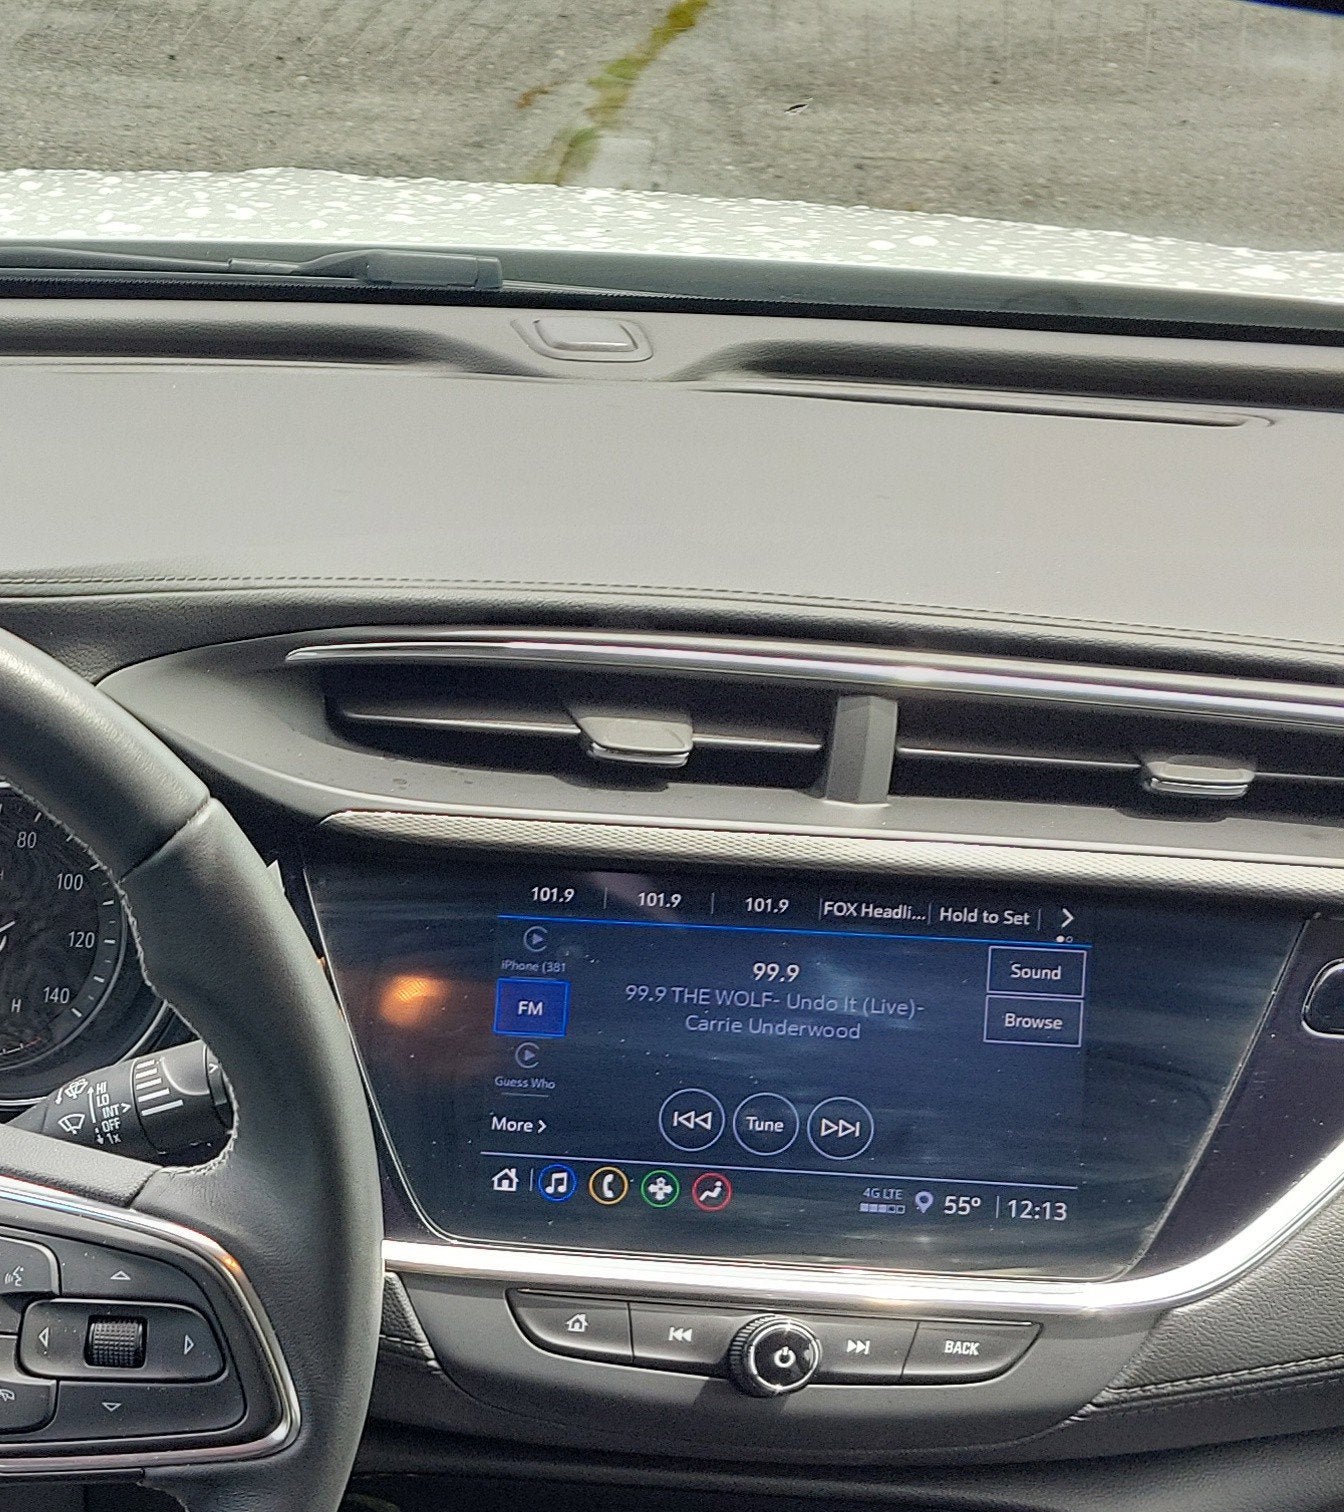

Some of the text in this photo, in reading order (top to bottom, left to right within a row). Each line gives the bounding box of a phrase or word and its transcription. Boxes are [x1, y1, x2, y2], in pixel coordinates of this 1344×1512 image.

[16, 831, 37, 849] 80
[56, 873, 84, 891] 100
[531, 886, 575, 903] 101.9
[637, 892, 682, 908] 101.9
[745, 898, 790, 914] 101.9
[823, 901, 927, 922] FOX Headli...
[939, 906, 1031, 926] Hold to Set
[68, 931, 95, 949] 120
[501, 959, 540, 973] iPhone
[752, 961, 801, 983] 99.9
[1010, 963, 1062, 981] Sound
[43, 987, 71, 1004] 140
[625, 984, 925, 1019] 99.9 THE WOLF- Undo It (Live)-
[11, 998, 22, 1013] H
[517, 1000, 544, 1016] FM
[686, 1014, 861, 1040] Carrie Underwood
[1004, 1012, 1063, 1031] Browse
[95, 1081, 108, 1095] HI
[494, 1075, 557, 1090] Guess Who
[96, 1093, 111, 1107] LO
[101, 1103, 120, 1118] INT
[100, 1117, 121, 1133] OFF
[491, 1115, 534, 1134] More
[745, 1115, 785, 1133] Tune
[861, 1186, 904, 1200] 4G LTE
[943, 1195, 982, 1216] 55°
[1007, 1198, 1069, 1221] 12:13
[944, 1338, 980, 1357] BACK
